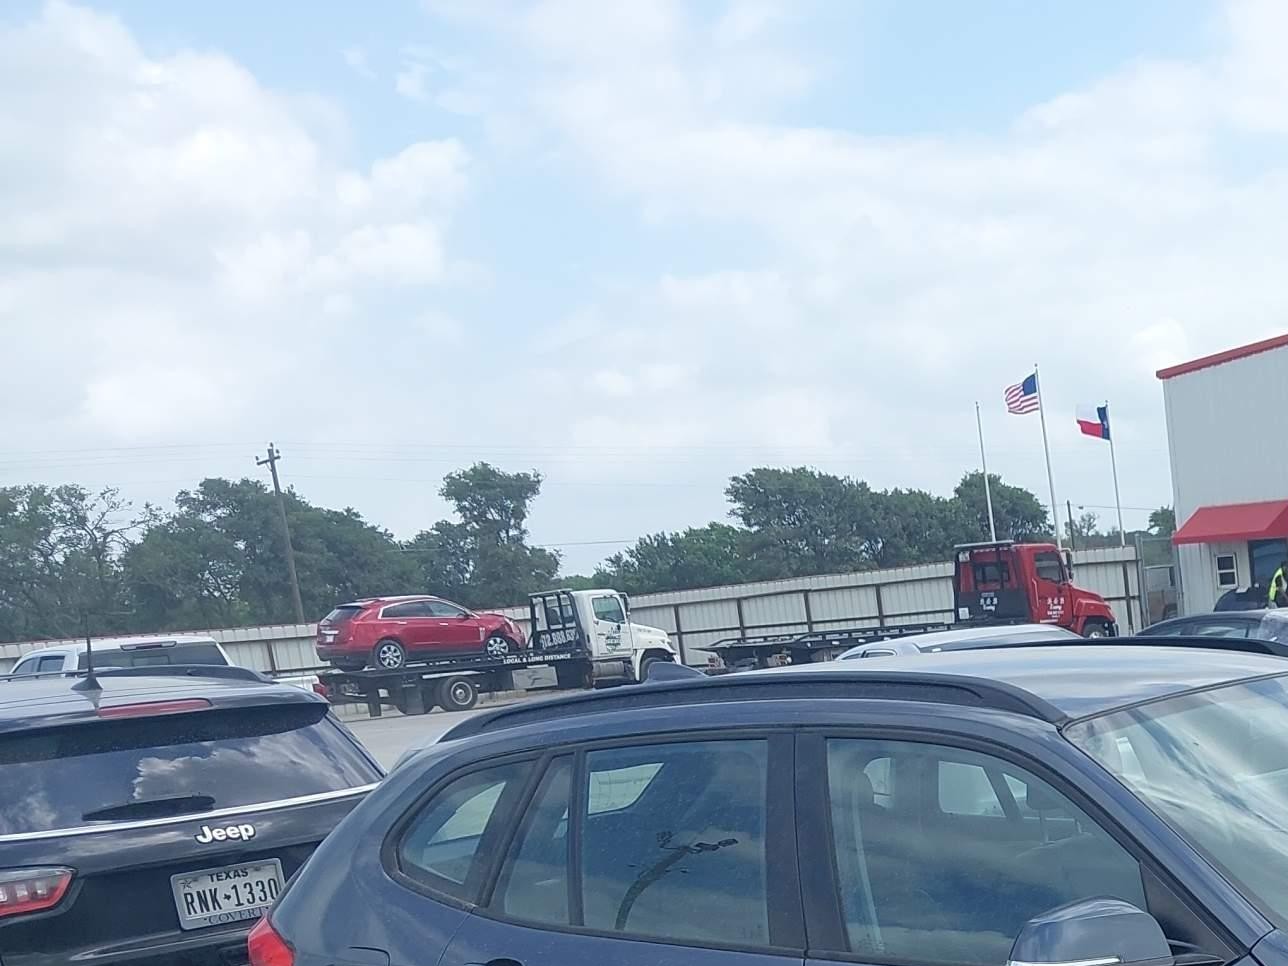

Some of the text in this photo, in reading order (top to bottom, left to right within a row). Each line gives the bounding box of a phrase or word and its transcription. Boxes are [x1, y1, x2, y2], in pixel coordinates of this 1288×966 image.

[544, 653, 571, 661] DISTANCE
[196, 823, 255, 843] Jeep
[208, 868, 248, 883] TEXAS
